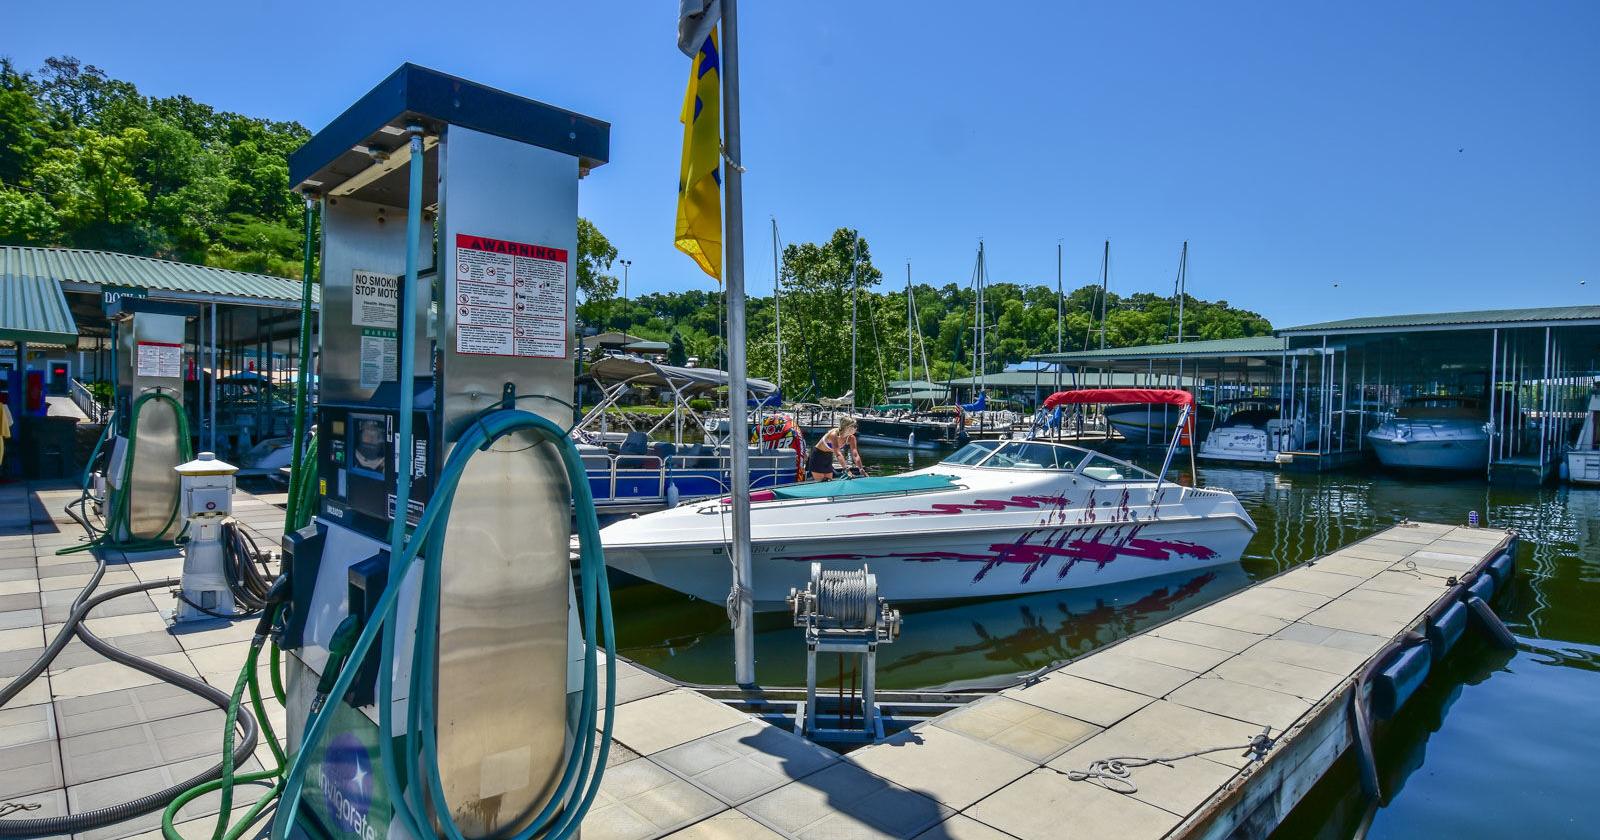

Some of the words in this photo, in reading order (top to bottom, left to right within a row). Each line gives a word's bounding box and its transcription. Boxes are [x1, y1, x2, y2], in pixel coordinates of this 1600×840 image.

[483, 240, 557, 261] WARNING
[355, 274, 367, 285] NO
[369, 276, 398, 288] SMOKIN
[355, 285, 376, 296] STOP
[377, 287, 398, 299] MOTO
[364, 329, 396, 338] WARNIN
